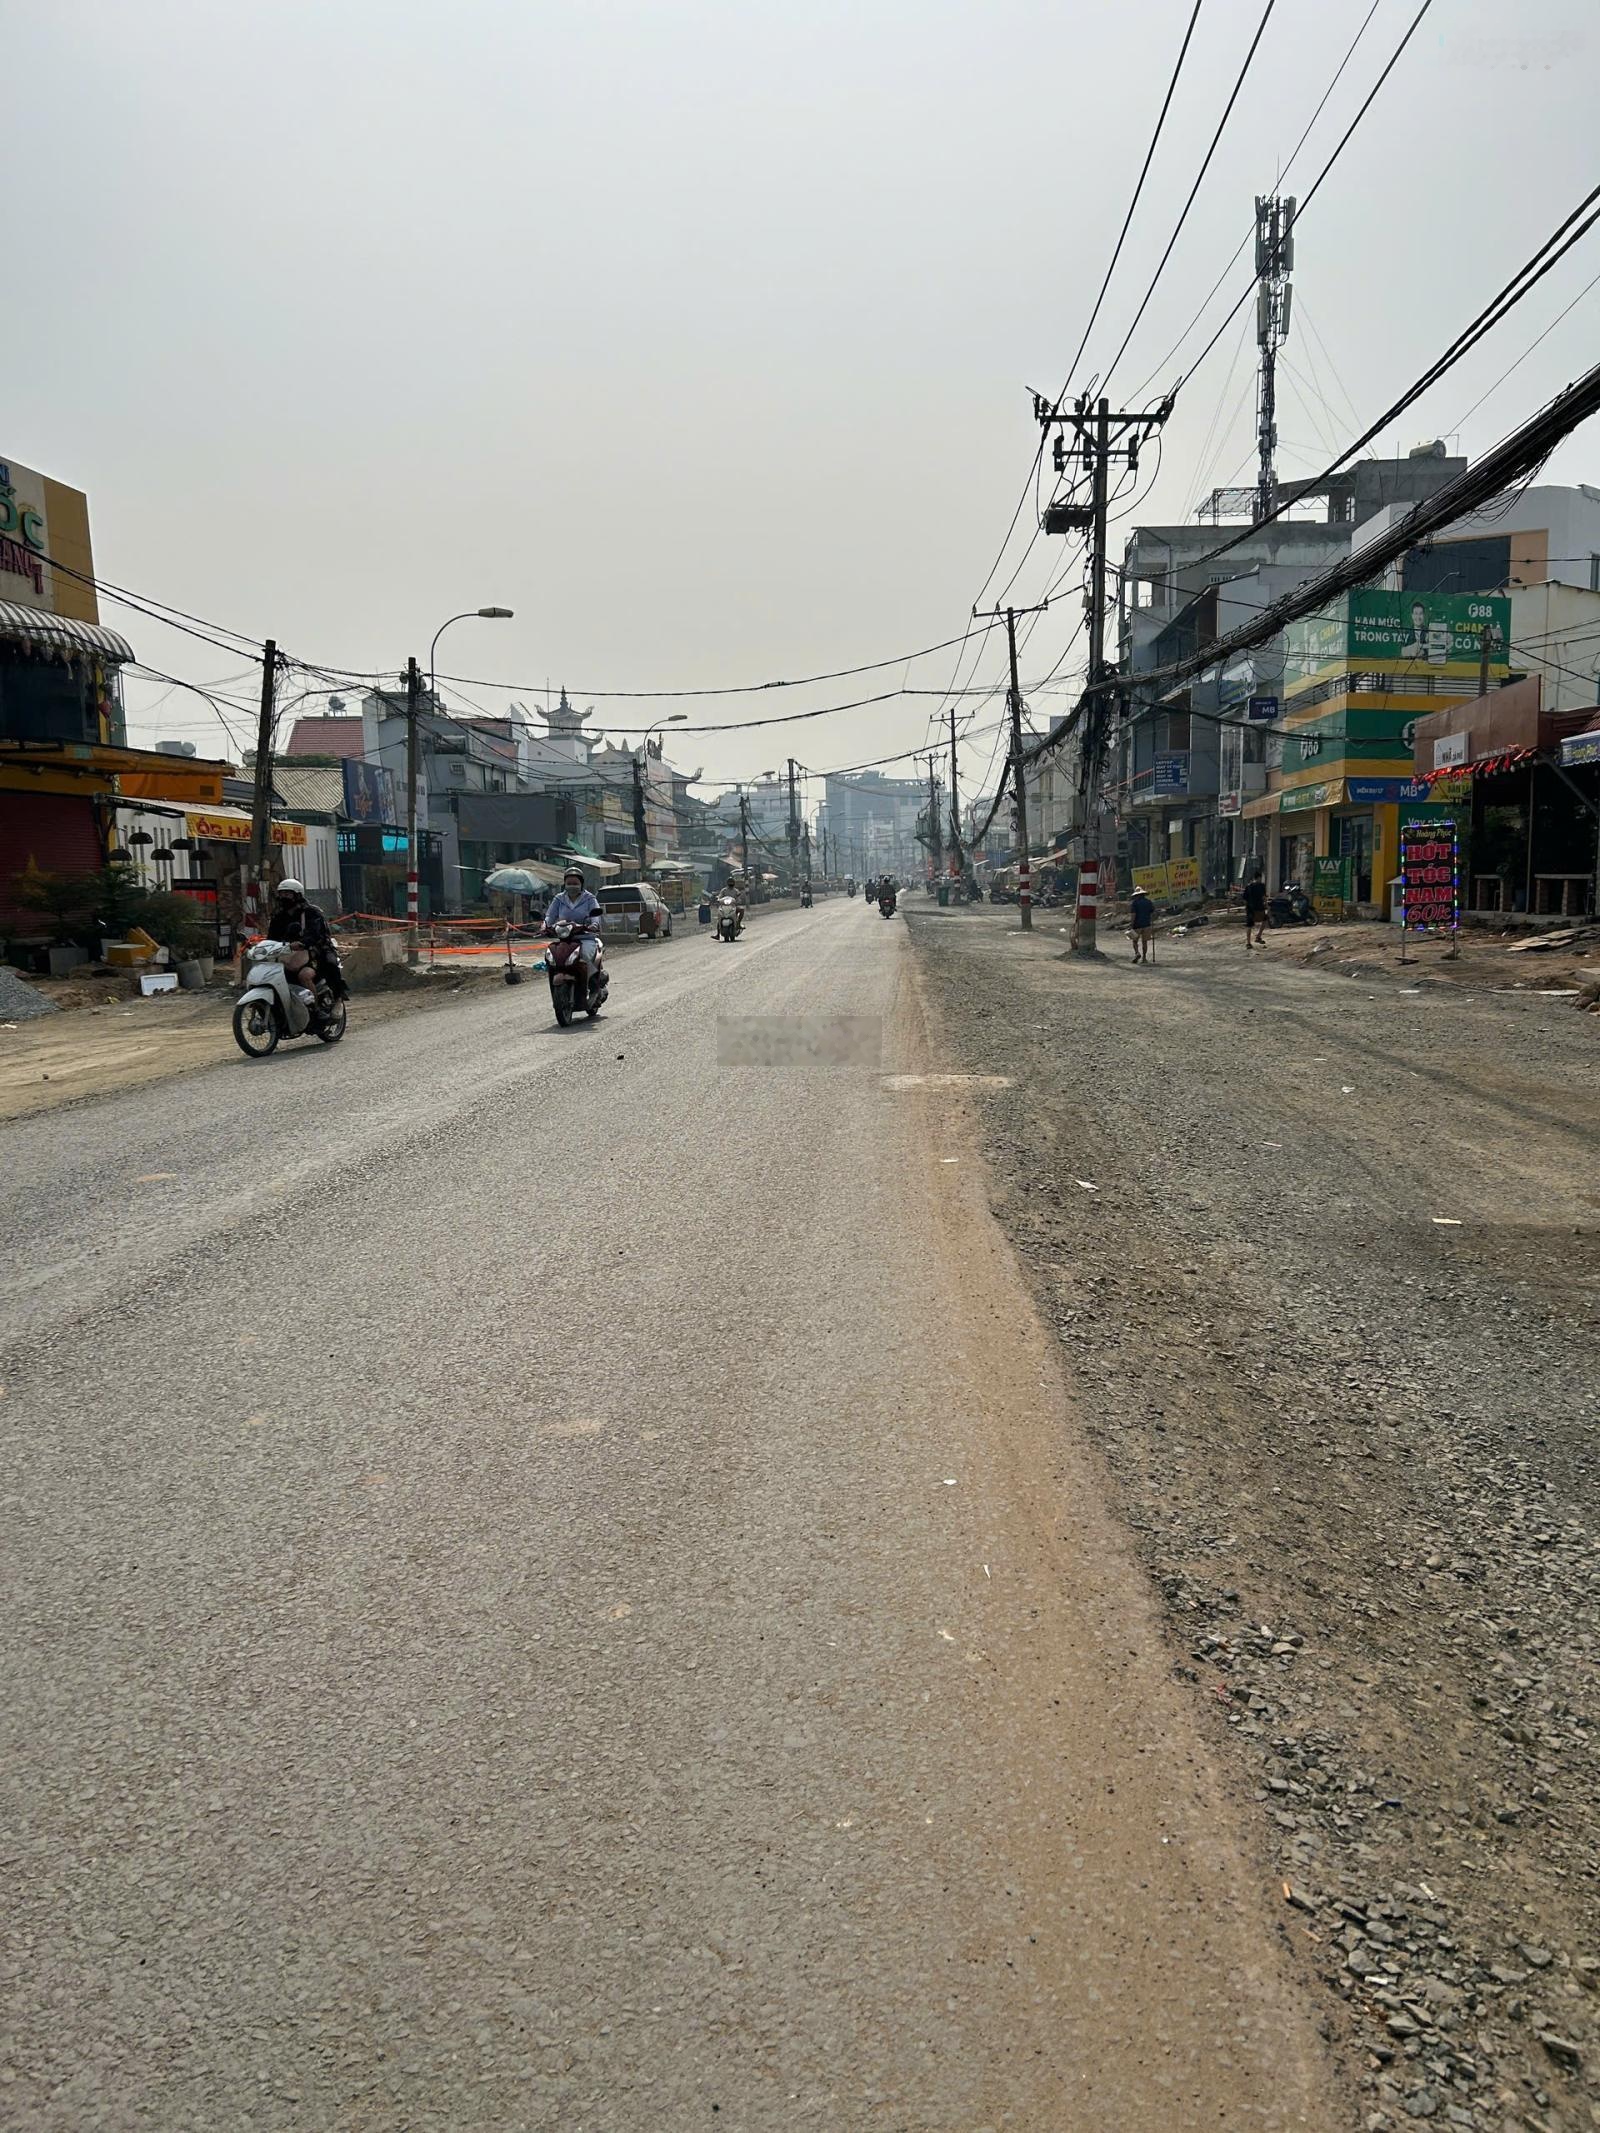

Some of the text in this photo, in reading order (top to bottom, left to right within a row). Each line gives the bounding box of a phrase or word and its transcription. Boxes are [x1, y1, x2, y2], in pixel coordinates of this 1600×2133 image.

[1468, 603, 1493, 618] F88
[1355, 631, 1390, 642] TRONG
[1455, 635, 1472, 650] CÓ
[1400, 785, 1418, 798] MB
[1407, 840, 1452, 862] HỚT
[1318, 860, 1342, 870] VAY
[1407, 863, 1451, 885] TÓC
[1406, 886, 1453, 904] NAM
[1406, 904, 1452, 922] 60k
